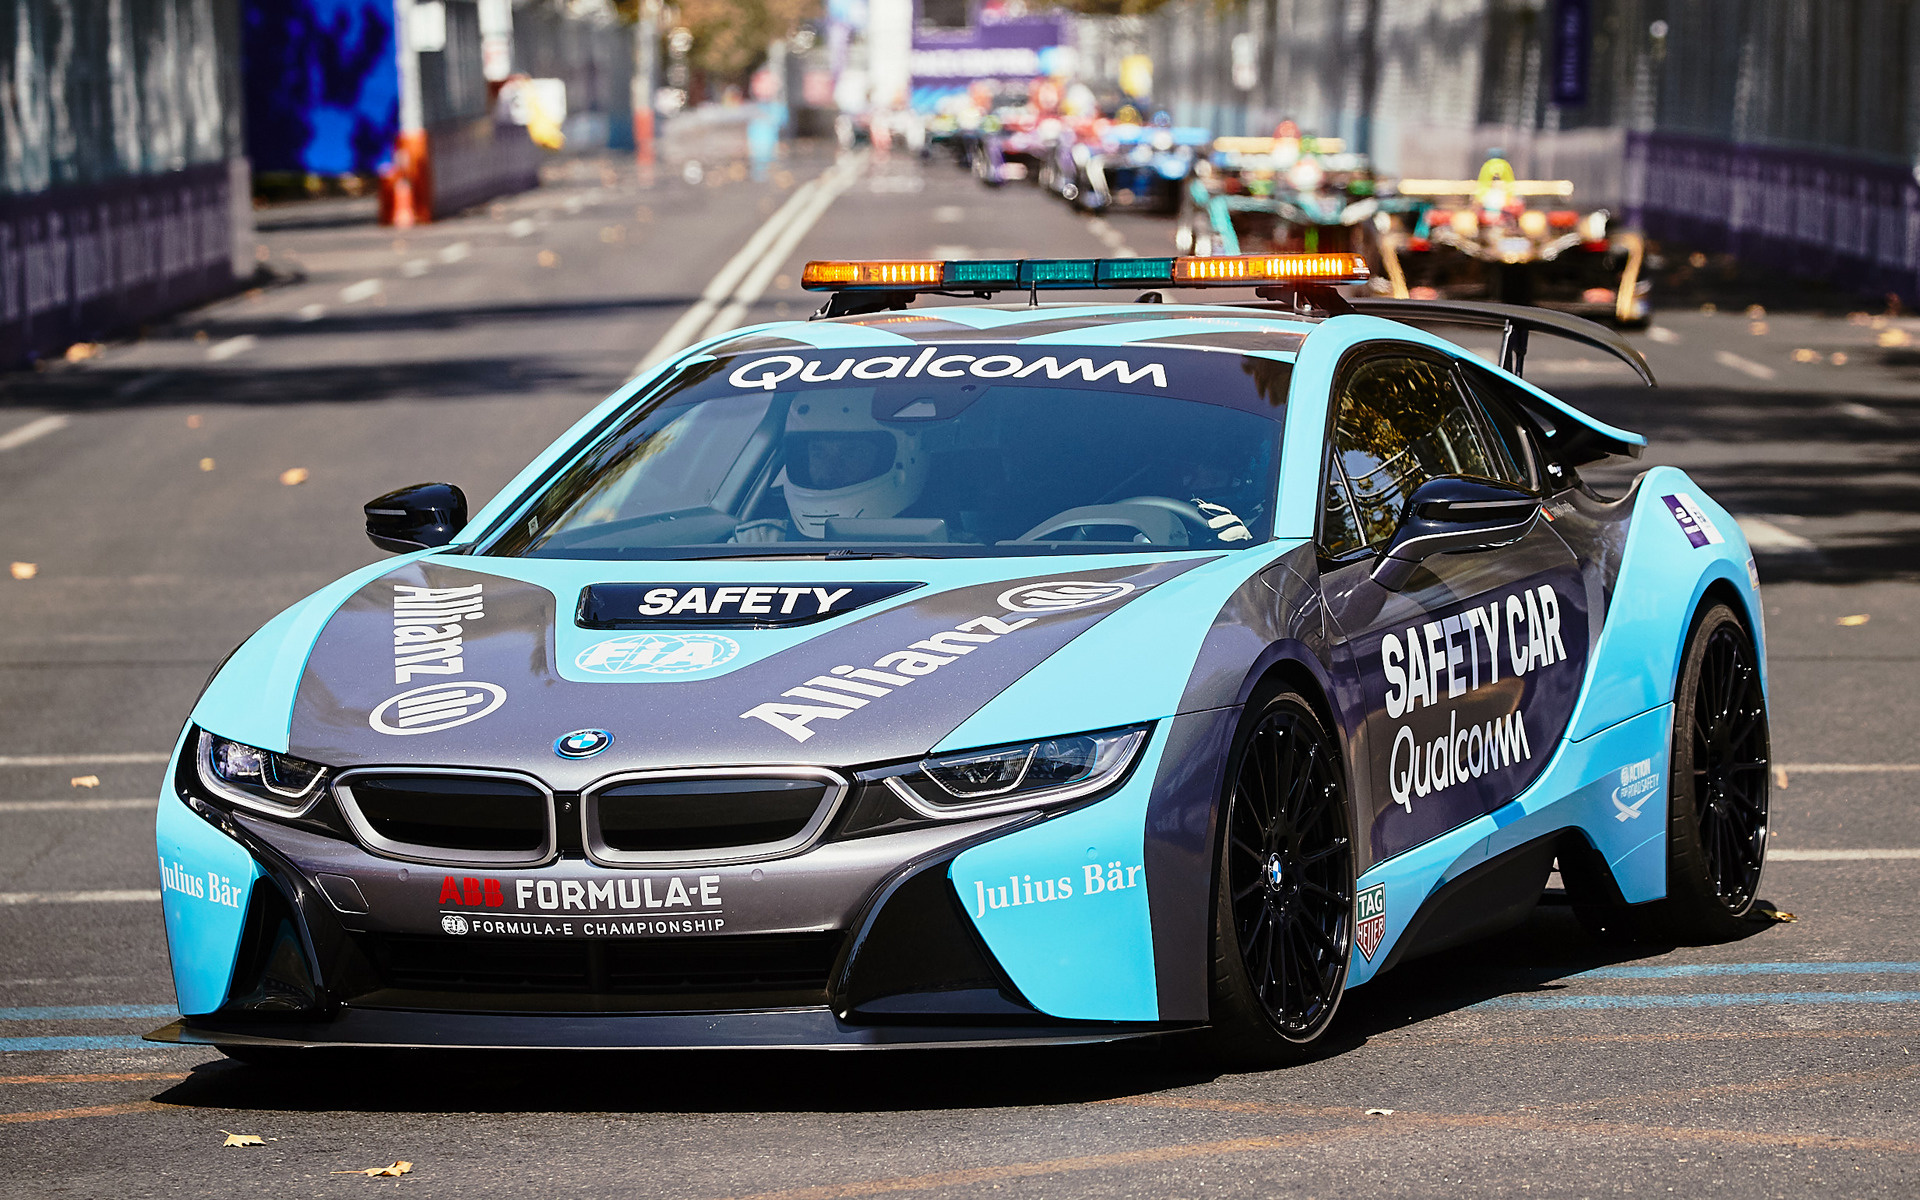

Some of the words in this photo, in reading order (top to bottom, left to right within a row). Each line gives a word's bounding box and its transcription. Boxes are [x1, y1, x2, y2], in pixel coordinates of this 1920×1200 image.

[728, 347, 1168, 390] Qualcomm
[638, 586, 853, 616] SAFETY
[393, 583, 485, 685] Allianz
[1381, 601, 1500, 719] SAFETY
[1506, 584, 1567, 677] CAR
[738, 615, 1039, 743] Allianz
[1389, 710, 1532, 814] Qualcomm
[1629, 758, 1651, 784] ACTION
[160, 856, 204, 899] Julius
[207, 871, 242, 909] Bär
[438, 875, 504, 908] ABB
[515, 875, 722, 911] FORMULA-E
[974, 874, 1074, 919] Julius
[1082, 860, 1142, 896] Bär
[1358, 889, 1383, 918] TAG
[472, 919, 574, 936] FORMULA-E
[583, 918, 726, 936] CHAMPIONSHIP
[1357, 917, 1384, 955] HEUER
